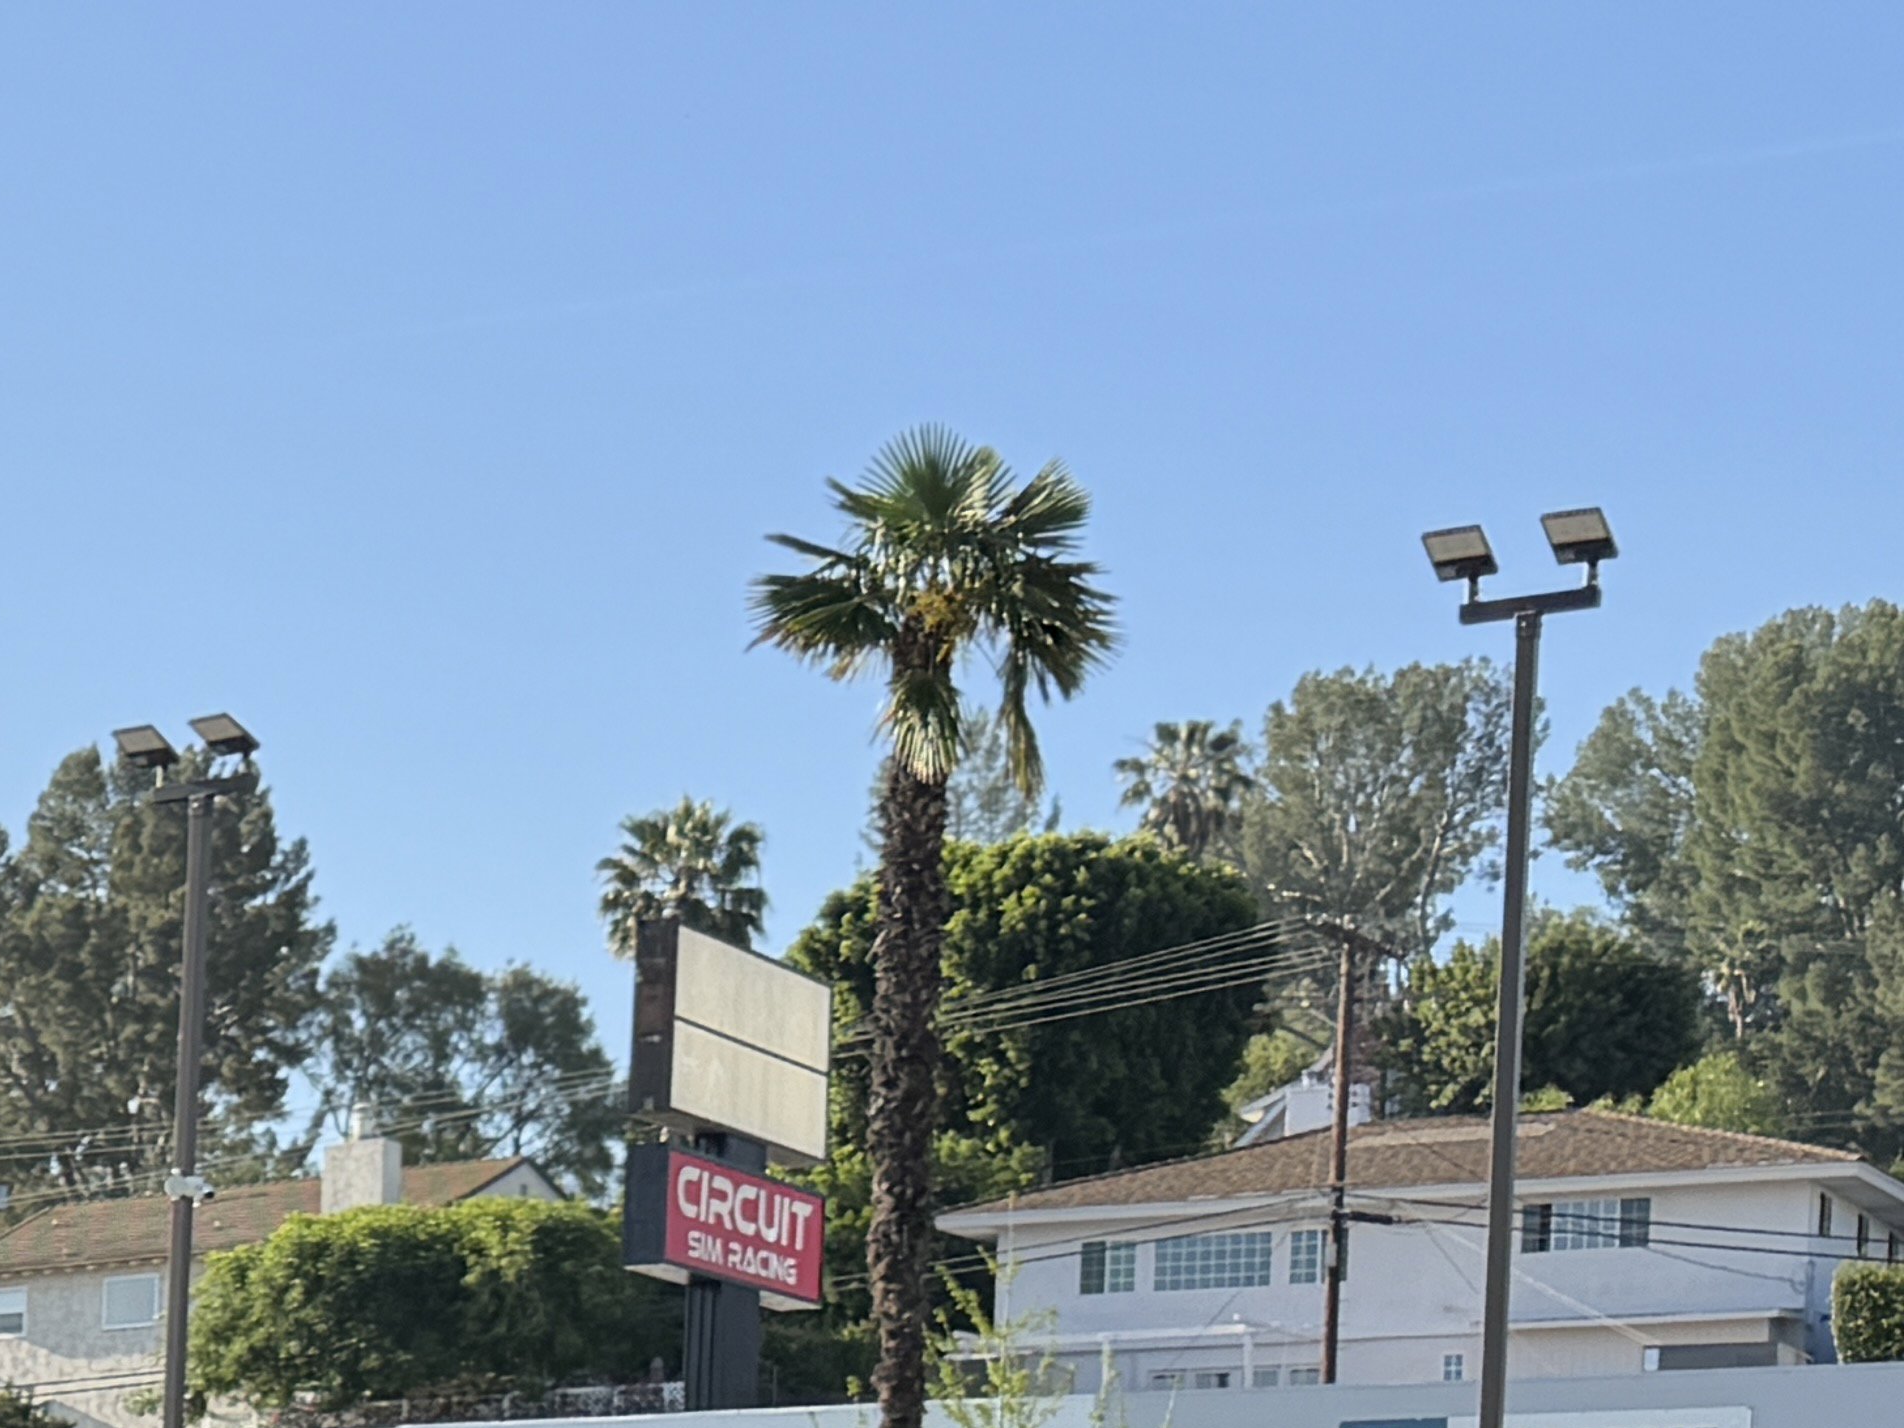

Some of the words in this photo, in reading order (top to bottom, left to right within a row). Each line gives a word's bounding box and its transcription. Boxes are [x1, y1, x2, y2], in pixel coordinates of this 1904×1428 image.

[677, 1166, 814, 1250] CIRCUIT
[687, 1230, 723, 1265] SIM
[727, 1242, 798, 1285] RACING
